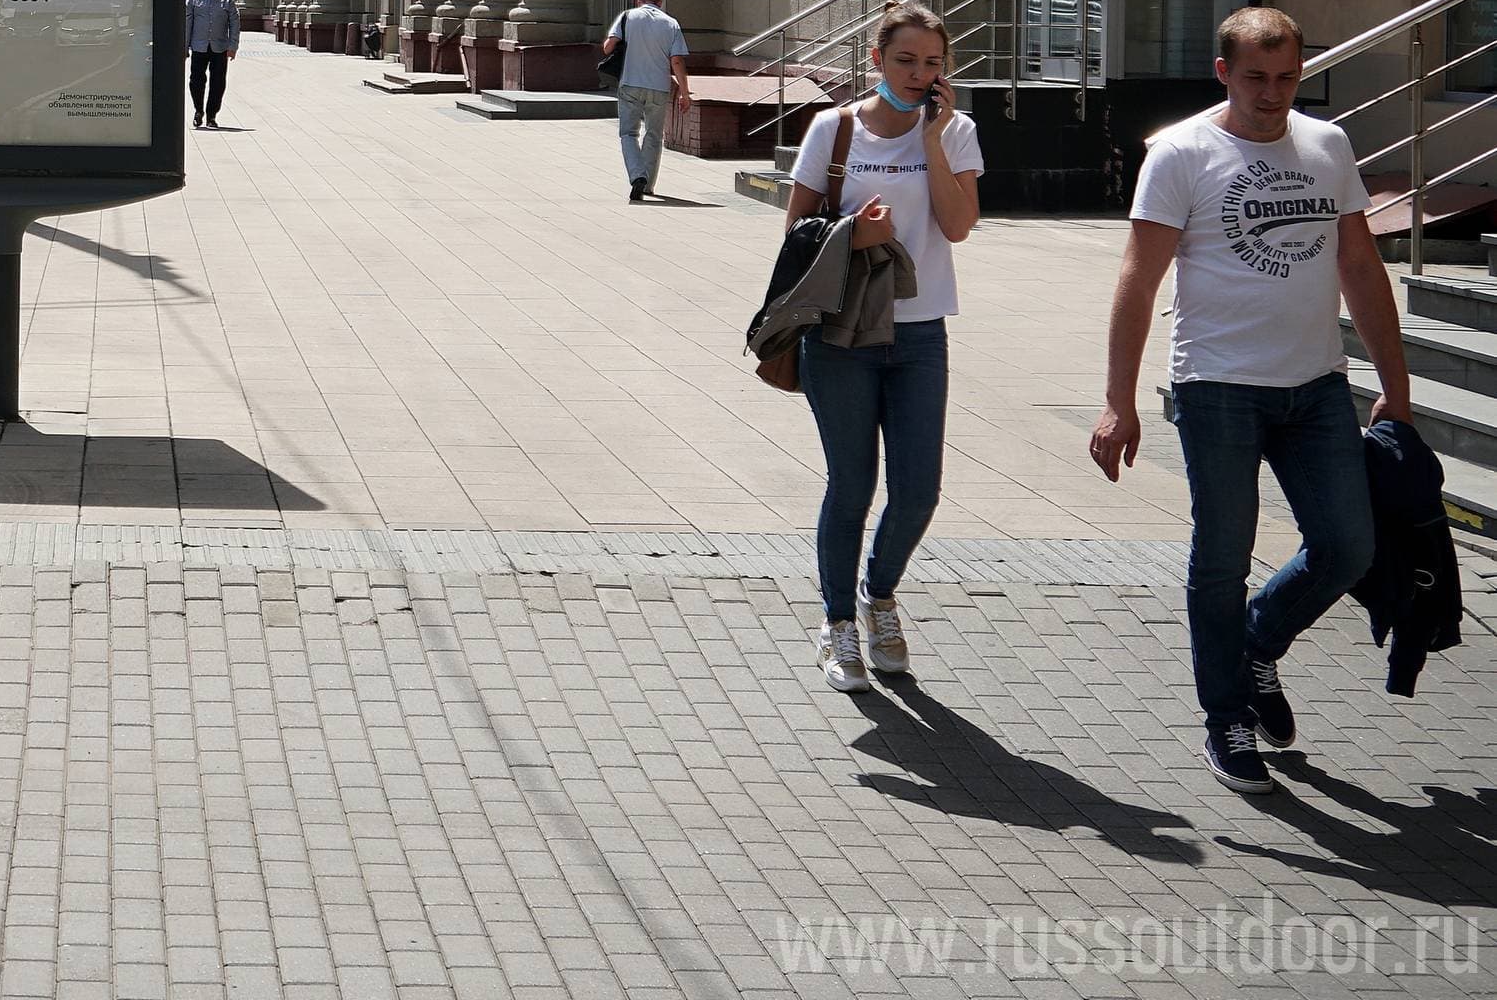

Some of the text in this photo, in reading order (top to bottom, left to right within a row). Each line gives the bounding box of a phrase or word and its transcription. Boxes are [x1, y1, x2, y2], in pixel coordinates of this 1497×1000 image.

[48, 101, 94, 109] объявления
[58, 92, 132, 102] Демонстрируемые
[850, 163, 887, 174] TOMMY
[1253, 170, 1315, 191] DENIM BRAND
[1243, 197, 1339, 220] ORIGINAL
[1222, 160, 1290, 279] CUSTOM CLOTHING CO.
[1252, 233, 1327, 263] QUALITY GARMENTS
